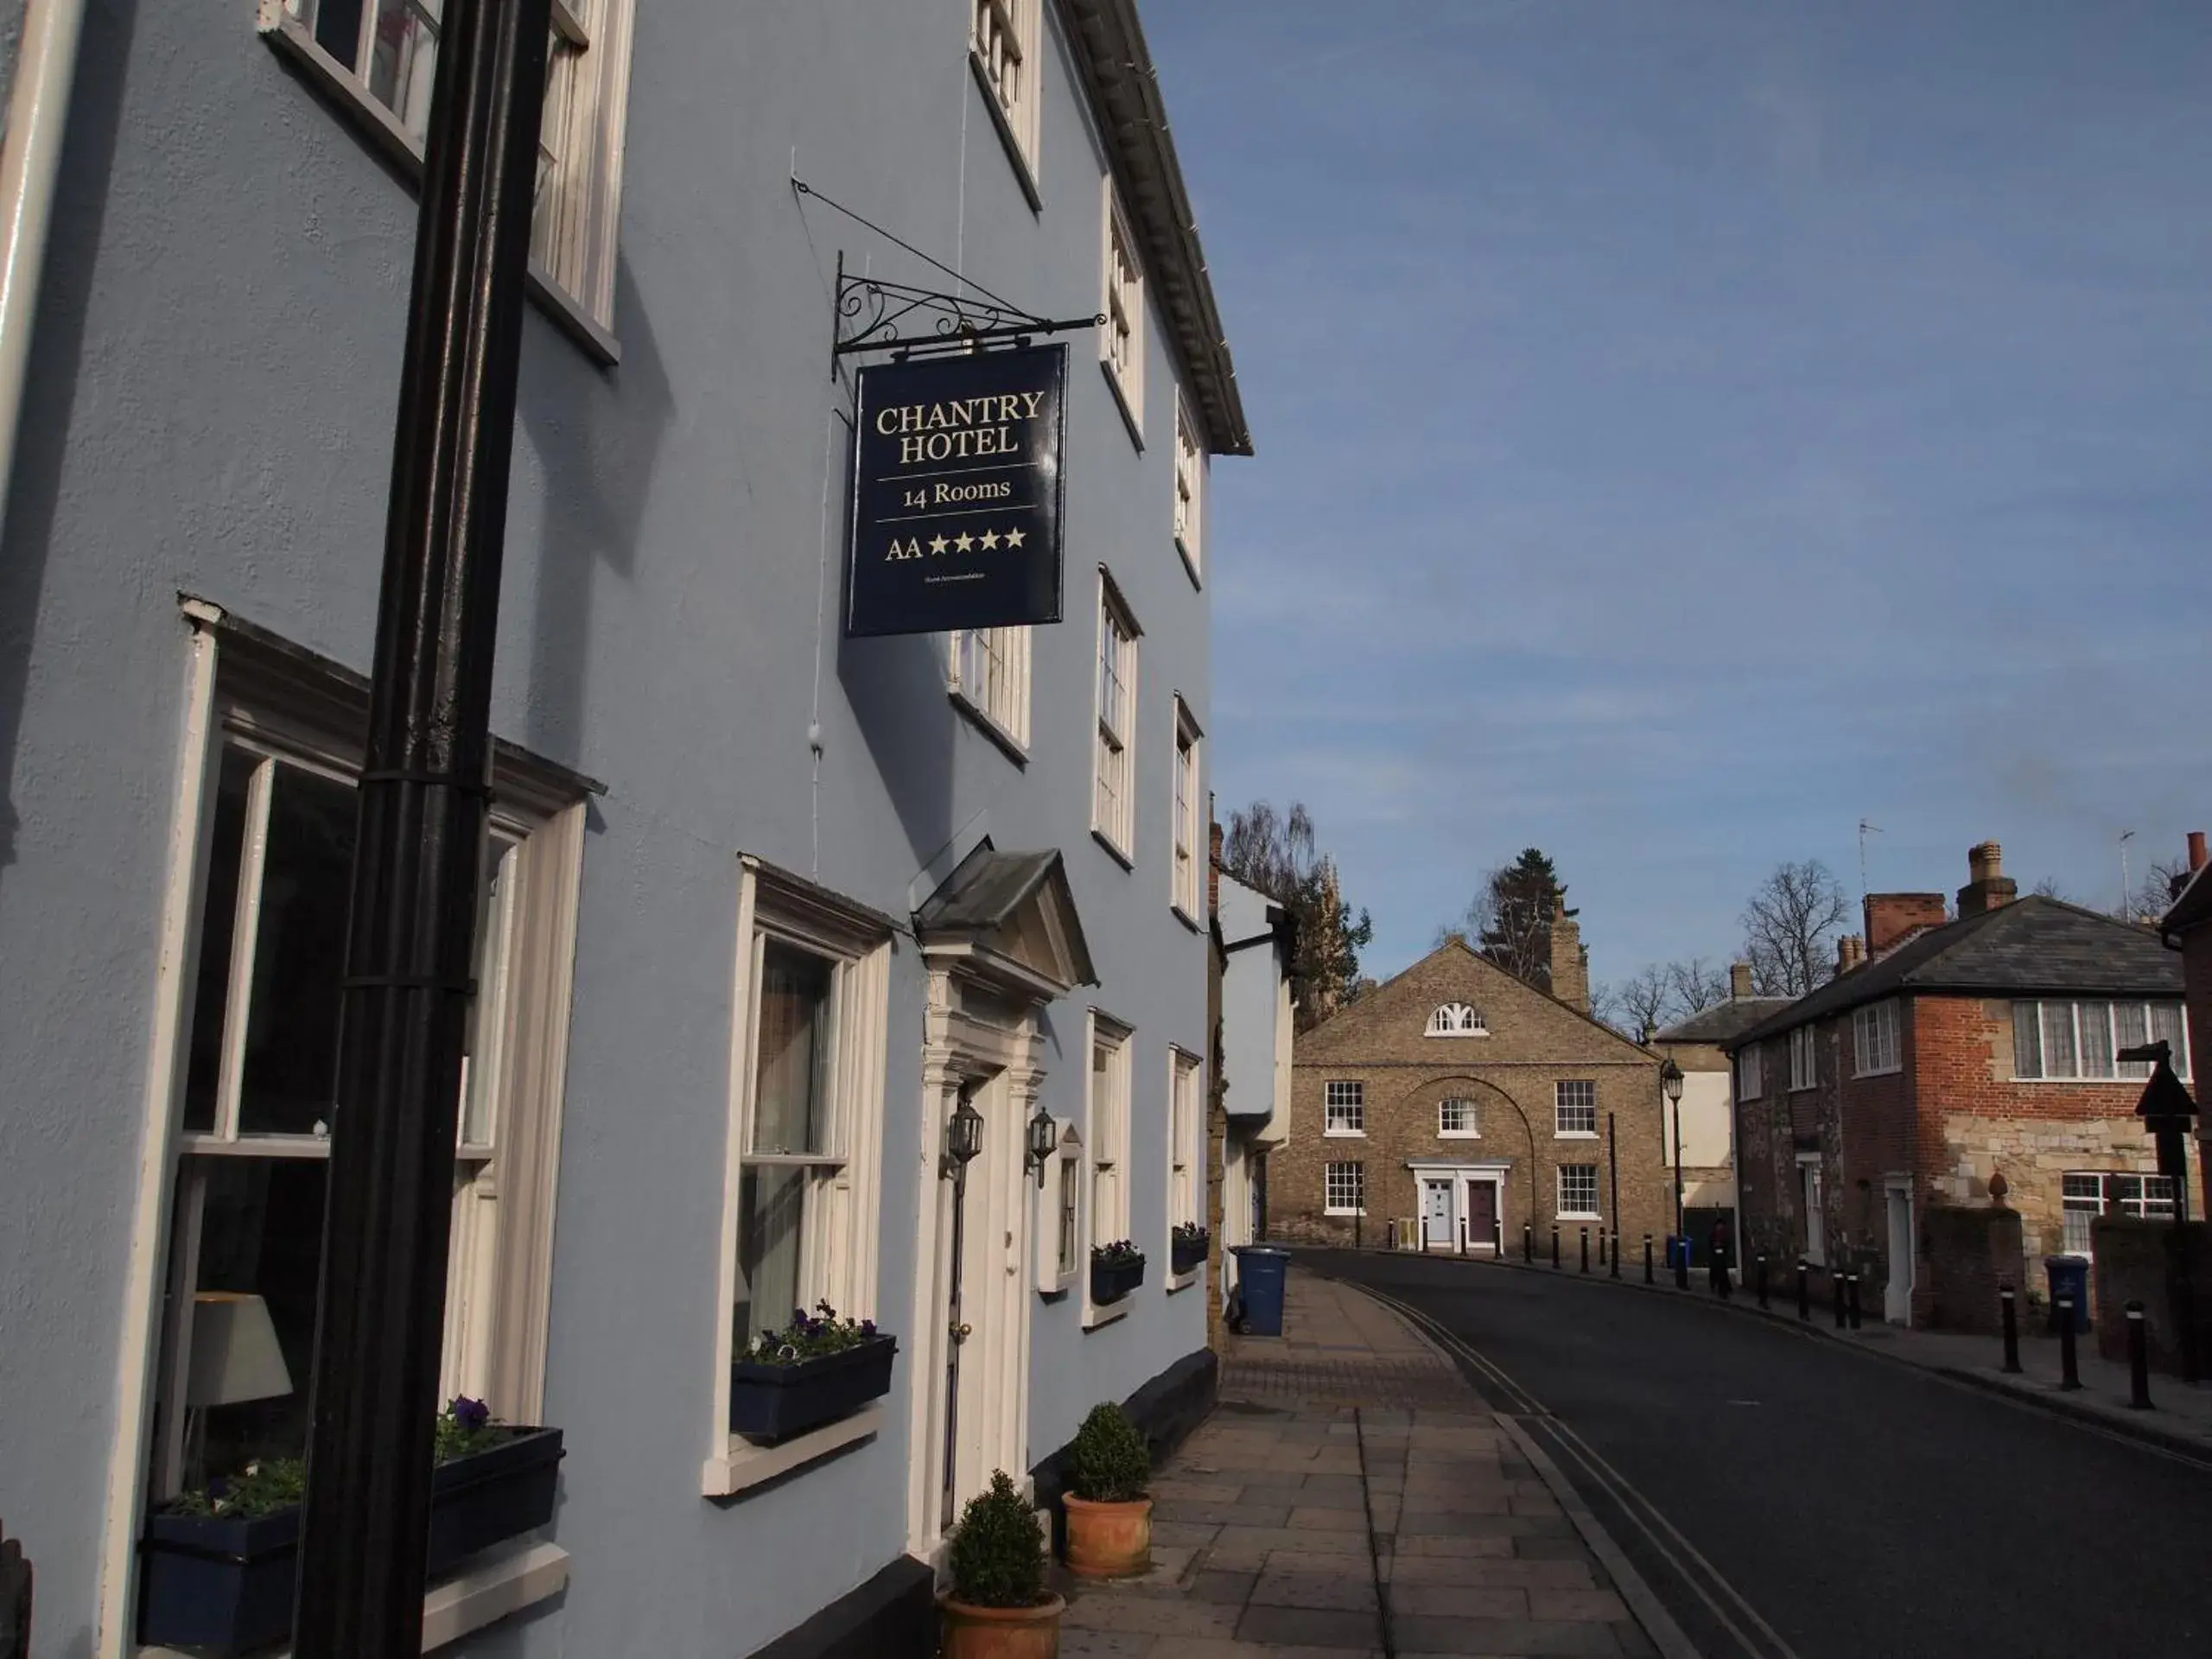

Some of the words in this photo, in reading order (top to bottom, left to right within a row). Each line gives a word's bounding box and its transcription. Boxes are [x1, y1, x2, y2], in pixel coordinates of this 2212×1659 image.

[876, 391, 1045, 435] CHANTRY
[899, 426, 1019, 464] HOTEL
[903, 489, 926, 509] 14
[934, 480, 1011, 504] Rooms
[885, 536, 924, 561] AA
